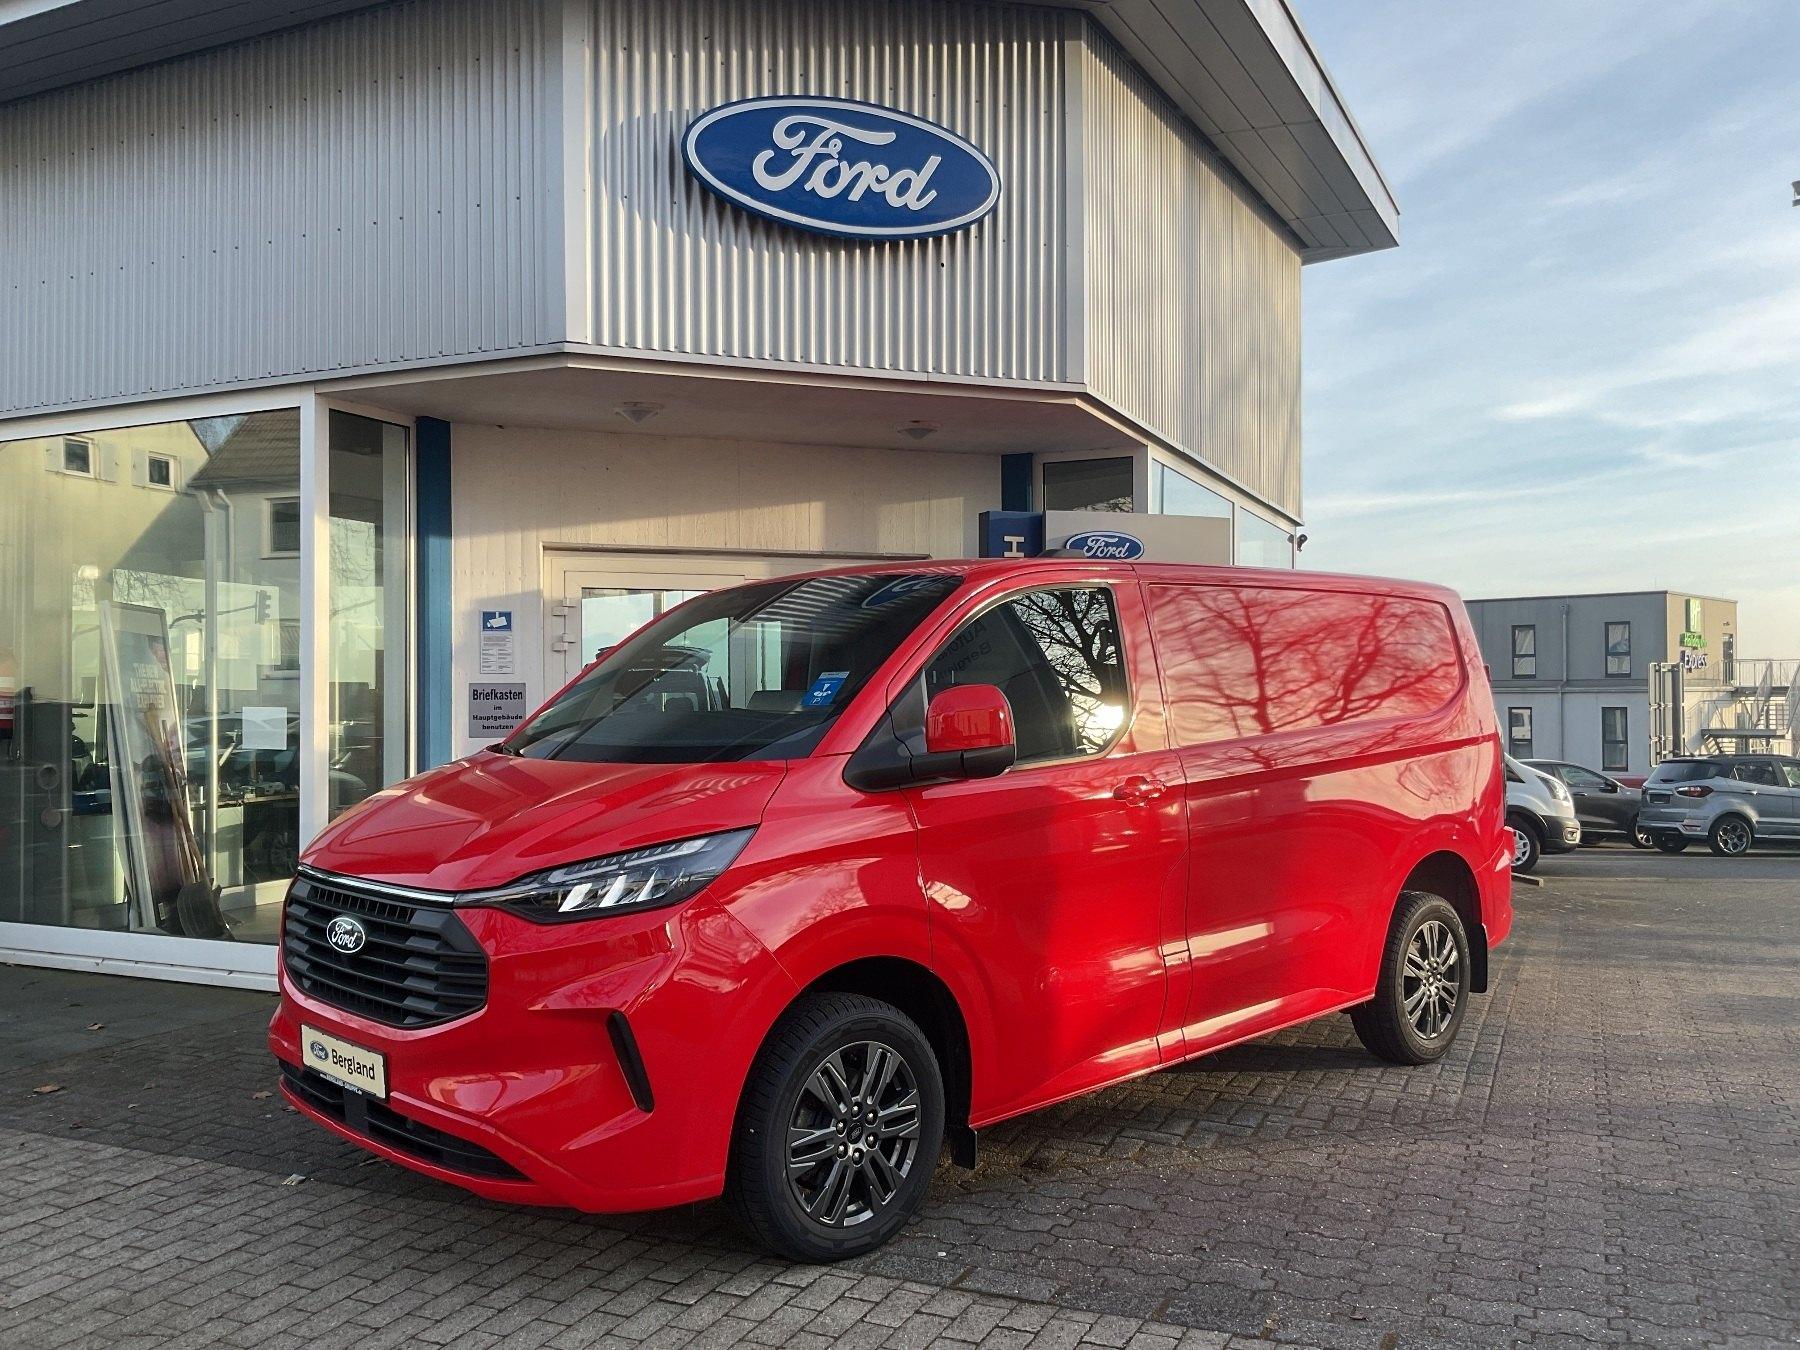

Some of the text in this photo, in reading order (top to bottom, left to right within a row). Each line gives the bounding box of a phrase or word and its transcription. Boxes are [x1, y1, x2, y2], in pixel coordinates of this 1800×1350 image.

[753, 115, 942, 211] Ford
[1083, 536, 1130, 558] Ford
[472, 689, 523, 701] Briefkasten
[331, 921, 356, 949] Ford
[313, 1042, 376, 1081] Ford Bergland
